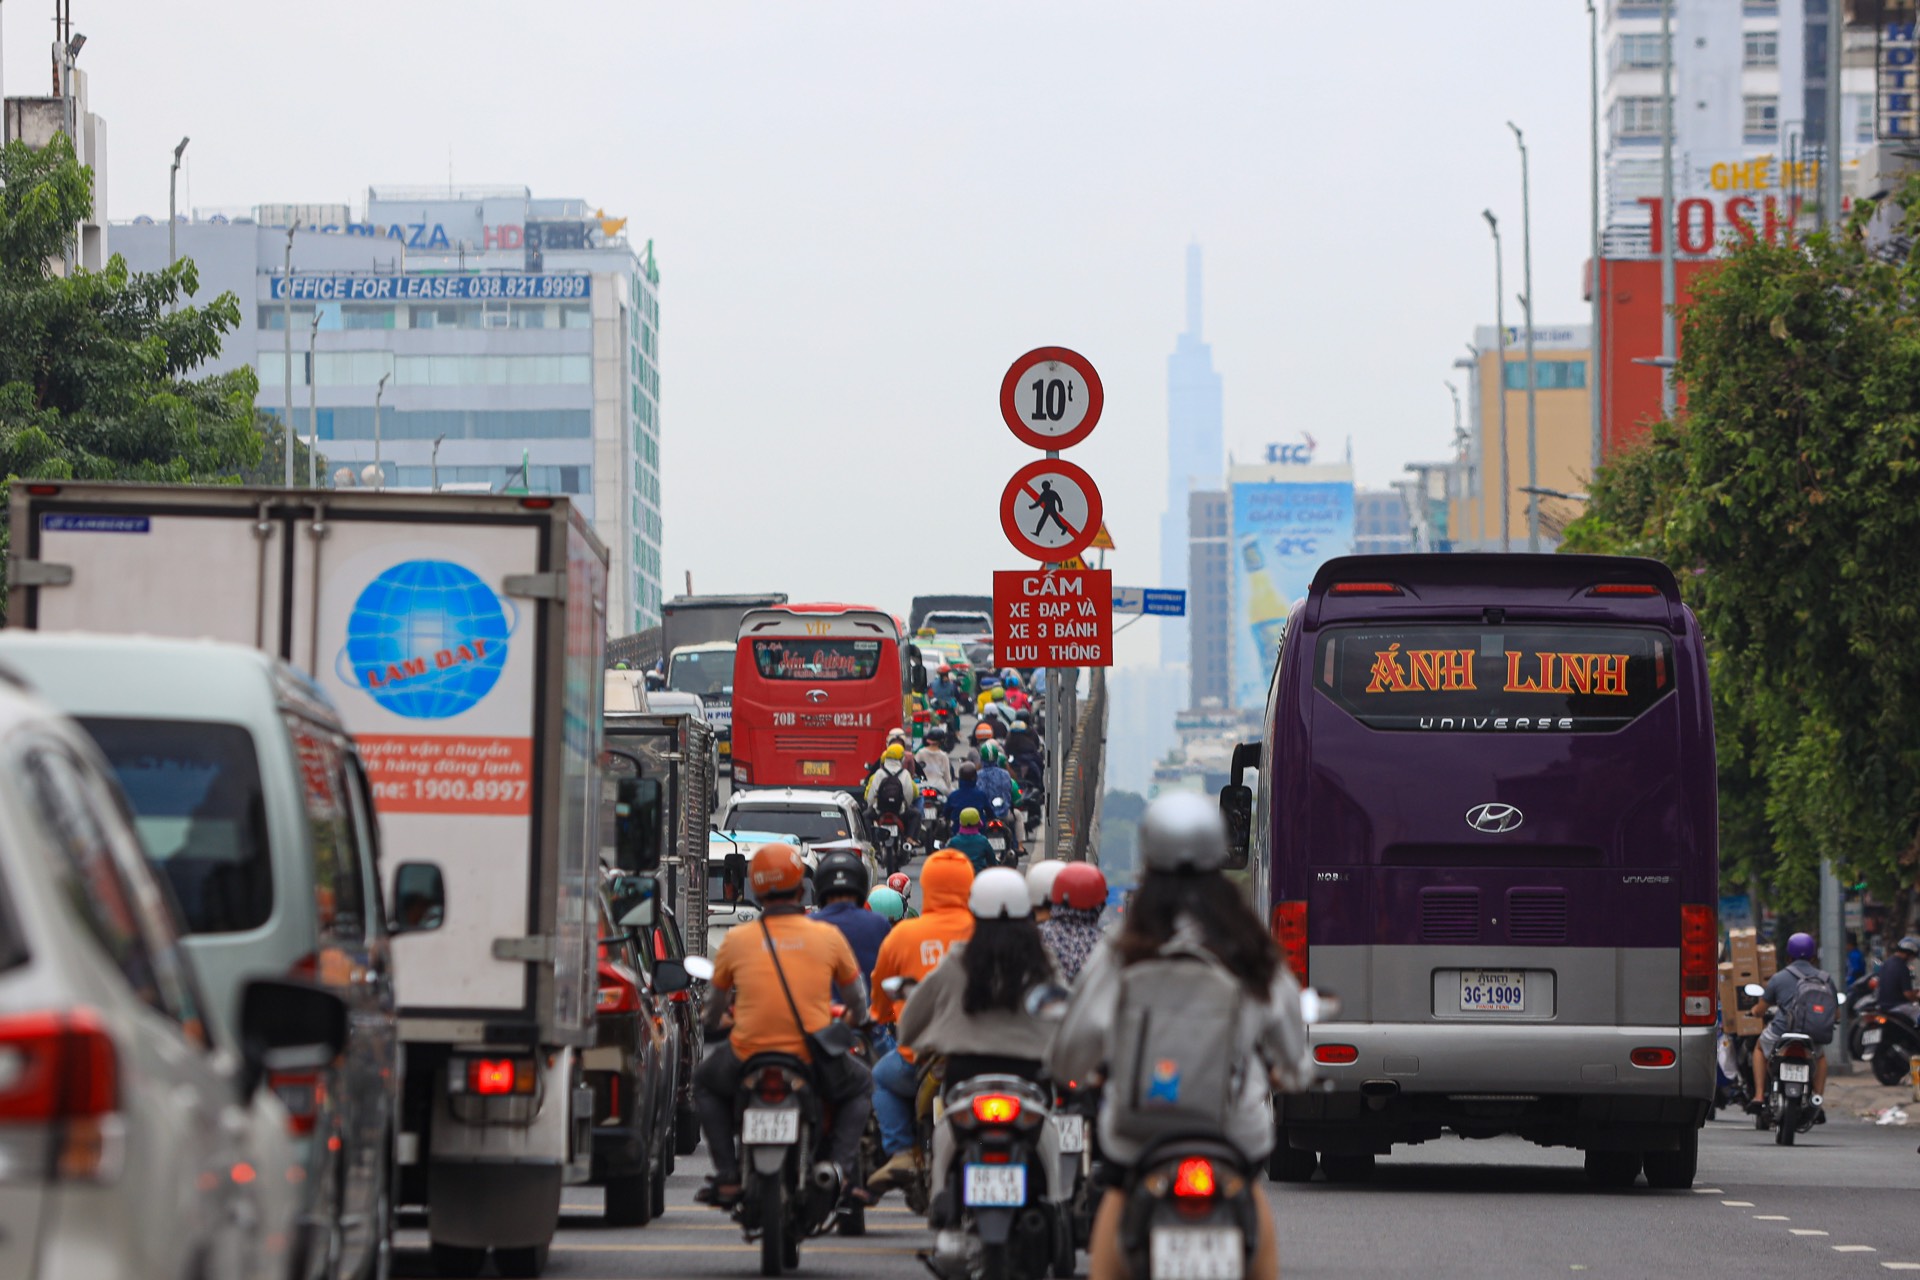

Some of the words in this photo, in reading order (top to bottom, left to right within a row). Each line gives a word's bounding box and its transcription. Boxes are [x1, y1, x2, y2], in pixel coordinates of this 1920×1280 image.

[277, 277, 347, 299] OFFICE
[351, 278, 390, 298] FOR
[397, 277, 464, 298] LEASE:
[468, 276, 585, 298] 038.821.9999
[1022, 569, 1083, 596] CẤM
[1009, 602, 1030, 618] XE
[1038, 602, 1071, 621] ĐẠP
[1077, 598, 1097, 617] VÀ
[805, 620, 831, 636] VIP
[1009, 623, 1030, 638] XE
[1037, 623, 1048, 638] 3
[1054, 618, 1098, 637] BÁNH
[1006, 645, 1038, 661] LƯU
[1049, 642, 1101, 660] THÔNG
[1365, 643, 1478, 693] ÁNH
[1502, 649, 1630, 696] LINH
[773, 712, 796, 726] 70B
[833, 712, 872, 727] 022.14
[1419, 717, 1574, 729] UNIVERSE
[413, 779, 529, 801] 1900.8997
[1464, 986, 1522, 1004] 3G-1909
